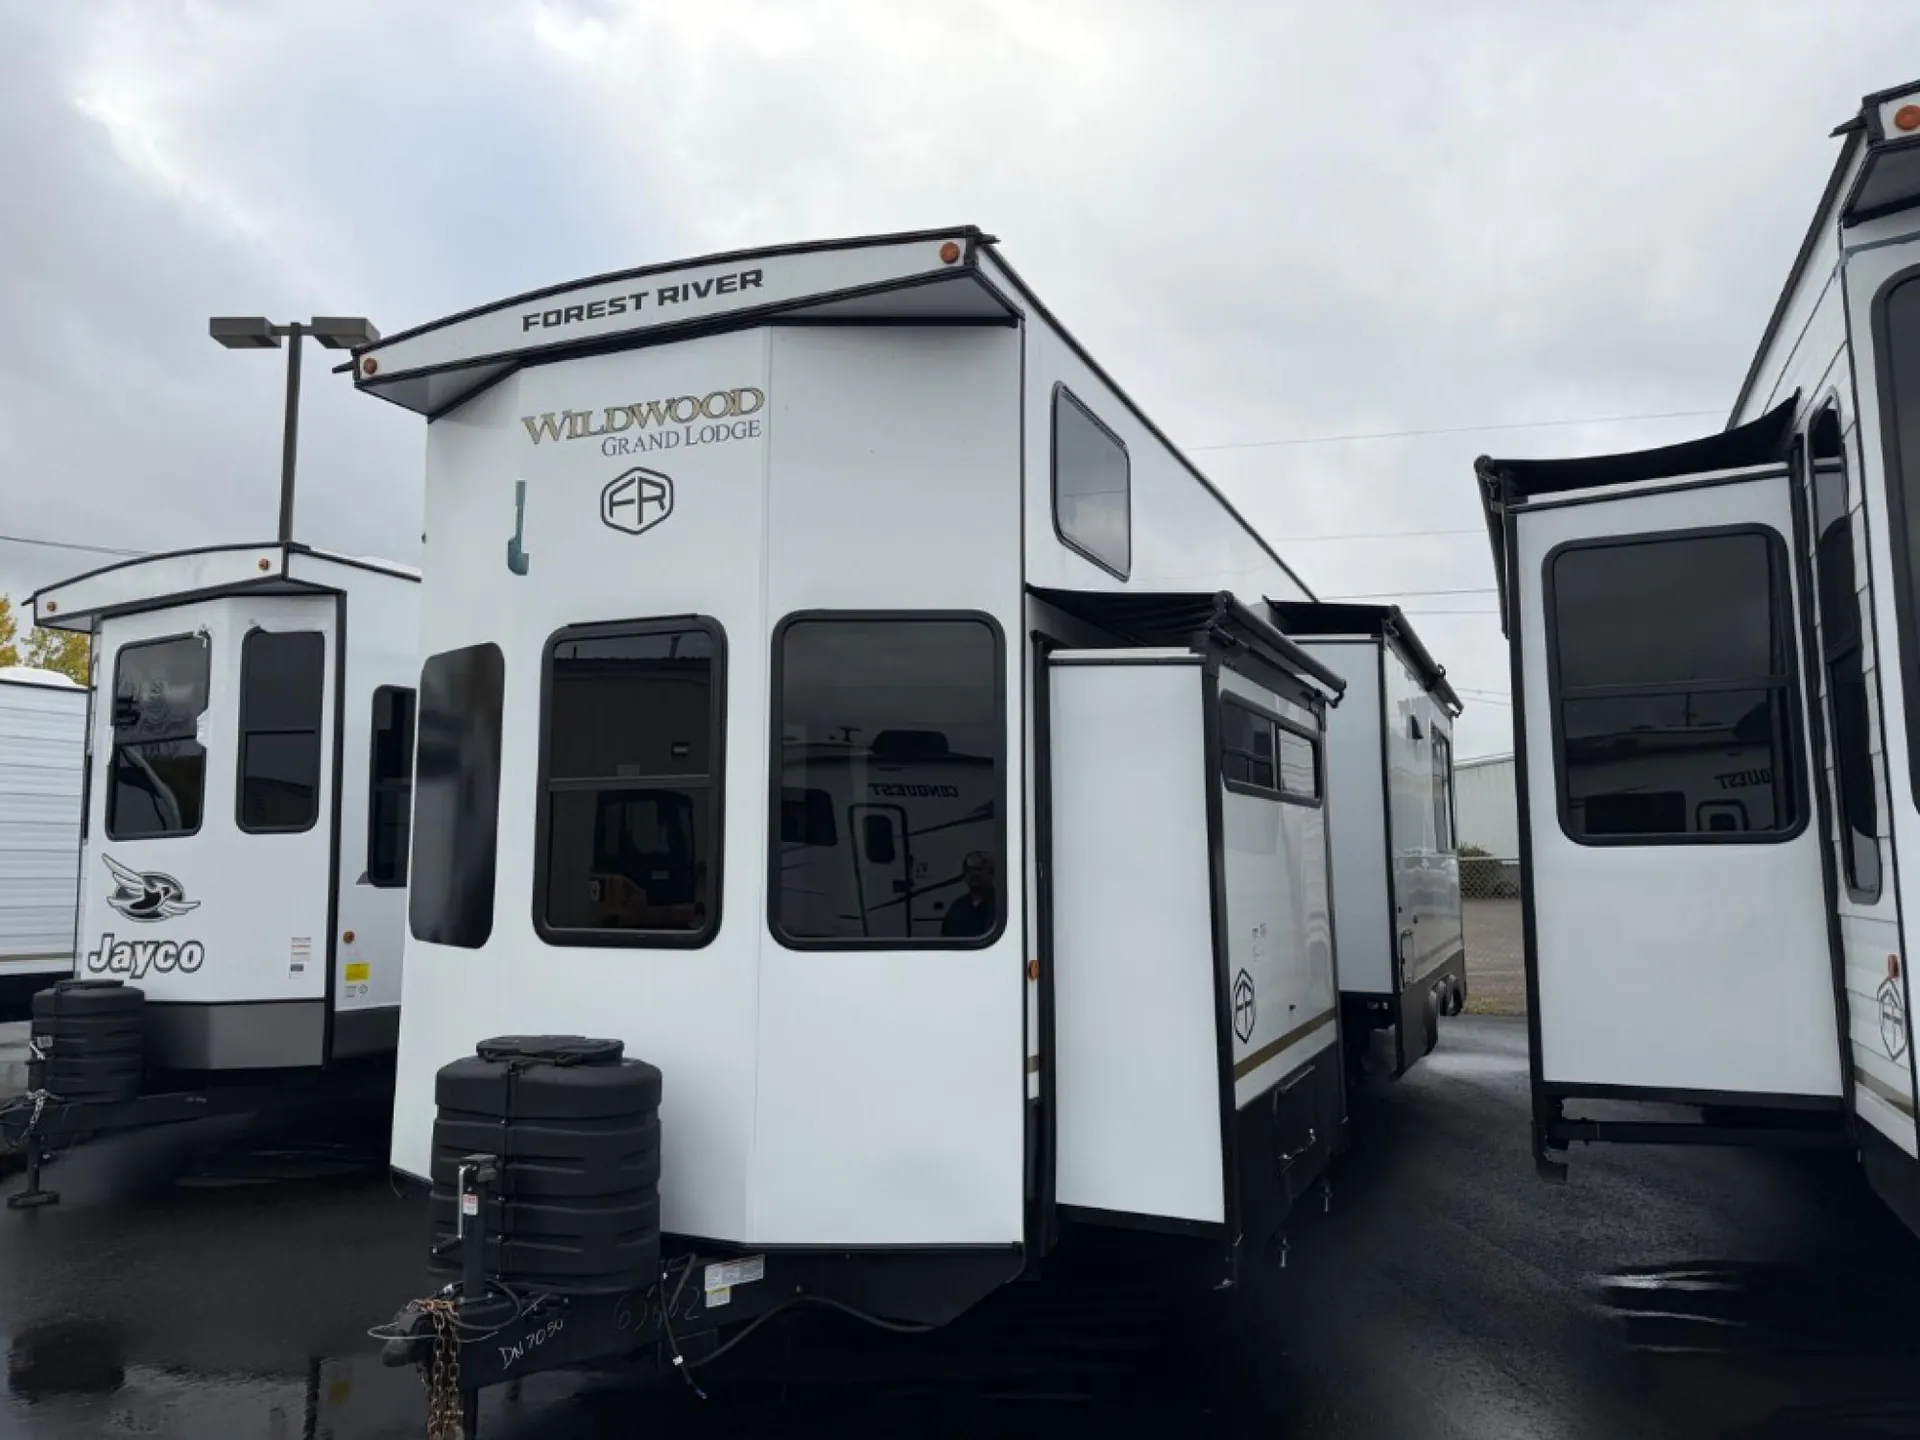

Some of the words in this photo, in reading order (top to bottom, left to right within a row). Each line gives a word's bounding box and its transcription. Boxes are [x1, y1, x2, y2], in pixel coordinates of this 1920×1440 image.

[522, 291, 649, 332] FOREST
[657, 268, 764, 306] RIVER
[521, 387, 766, 445] WILDWOOD
[601, 430, 680, 457] GRAND
[685, 419, 762, 447] LODGE
[608, 474, 667, 525] FR
[87, 932, 206, 979] Jayco
